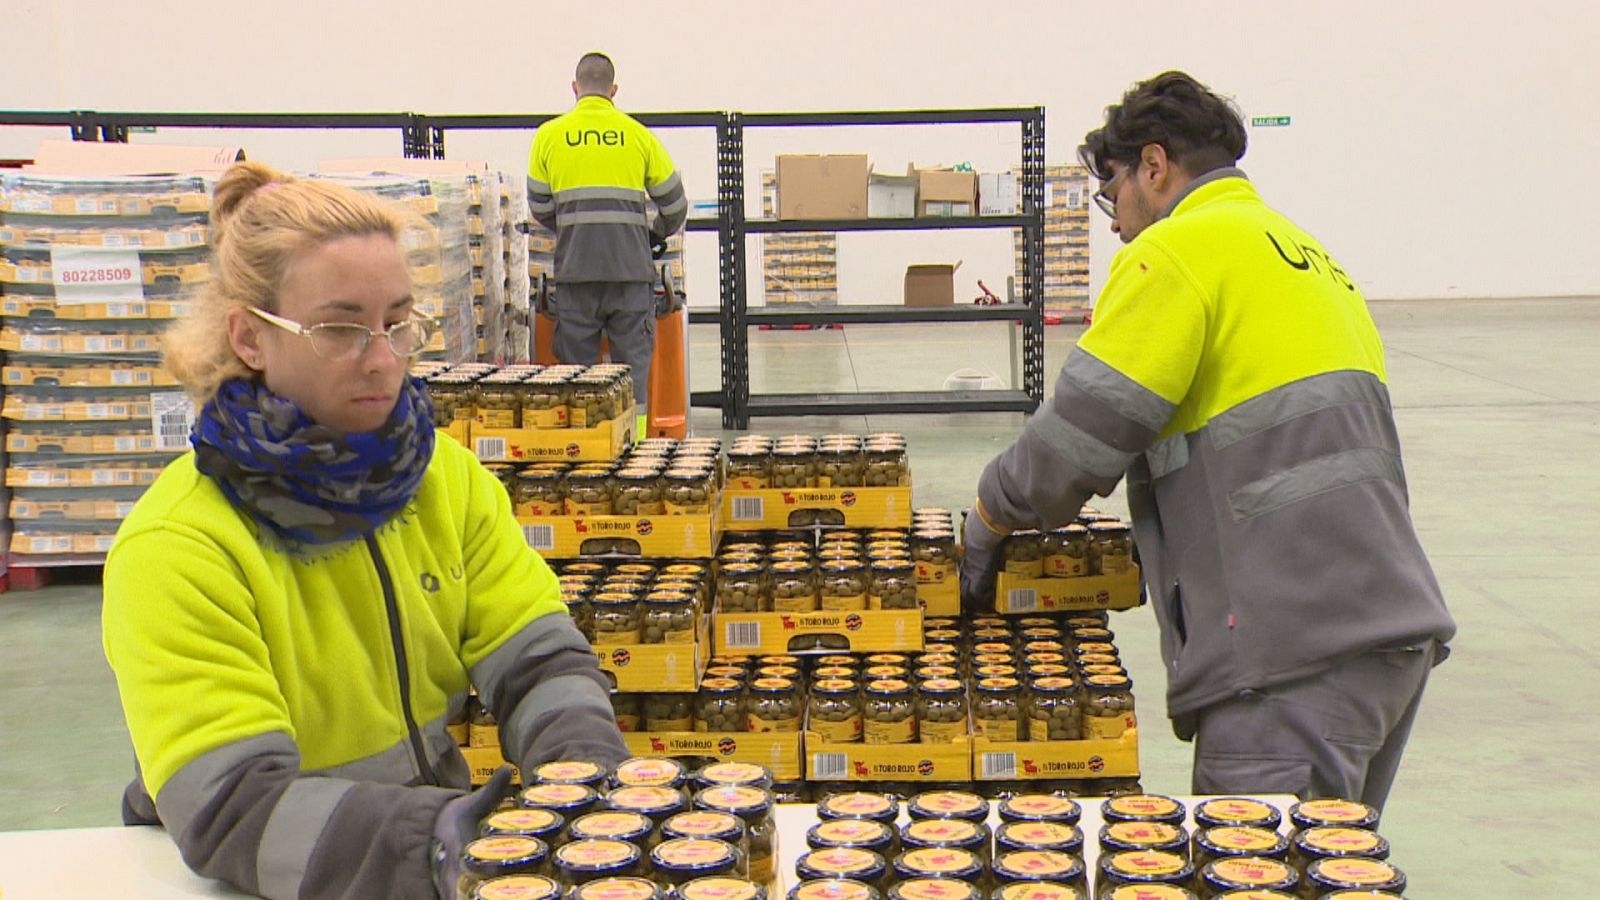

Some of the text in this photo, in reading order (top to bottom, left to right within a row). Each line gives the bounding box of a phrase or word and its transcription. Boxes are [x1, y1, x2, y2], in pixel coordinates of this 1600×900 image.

[1253, 118, 1279, 127] SALIDA
[565, 129, 625, 147] unei
[62, 268, 132, 283] 80228509
[675, 740, 693, 748] TORO
[879, 764, 896, 773] TORO
[897, 764, 915, 773] ROJO
